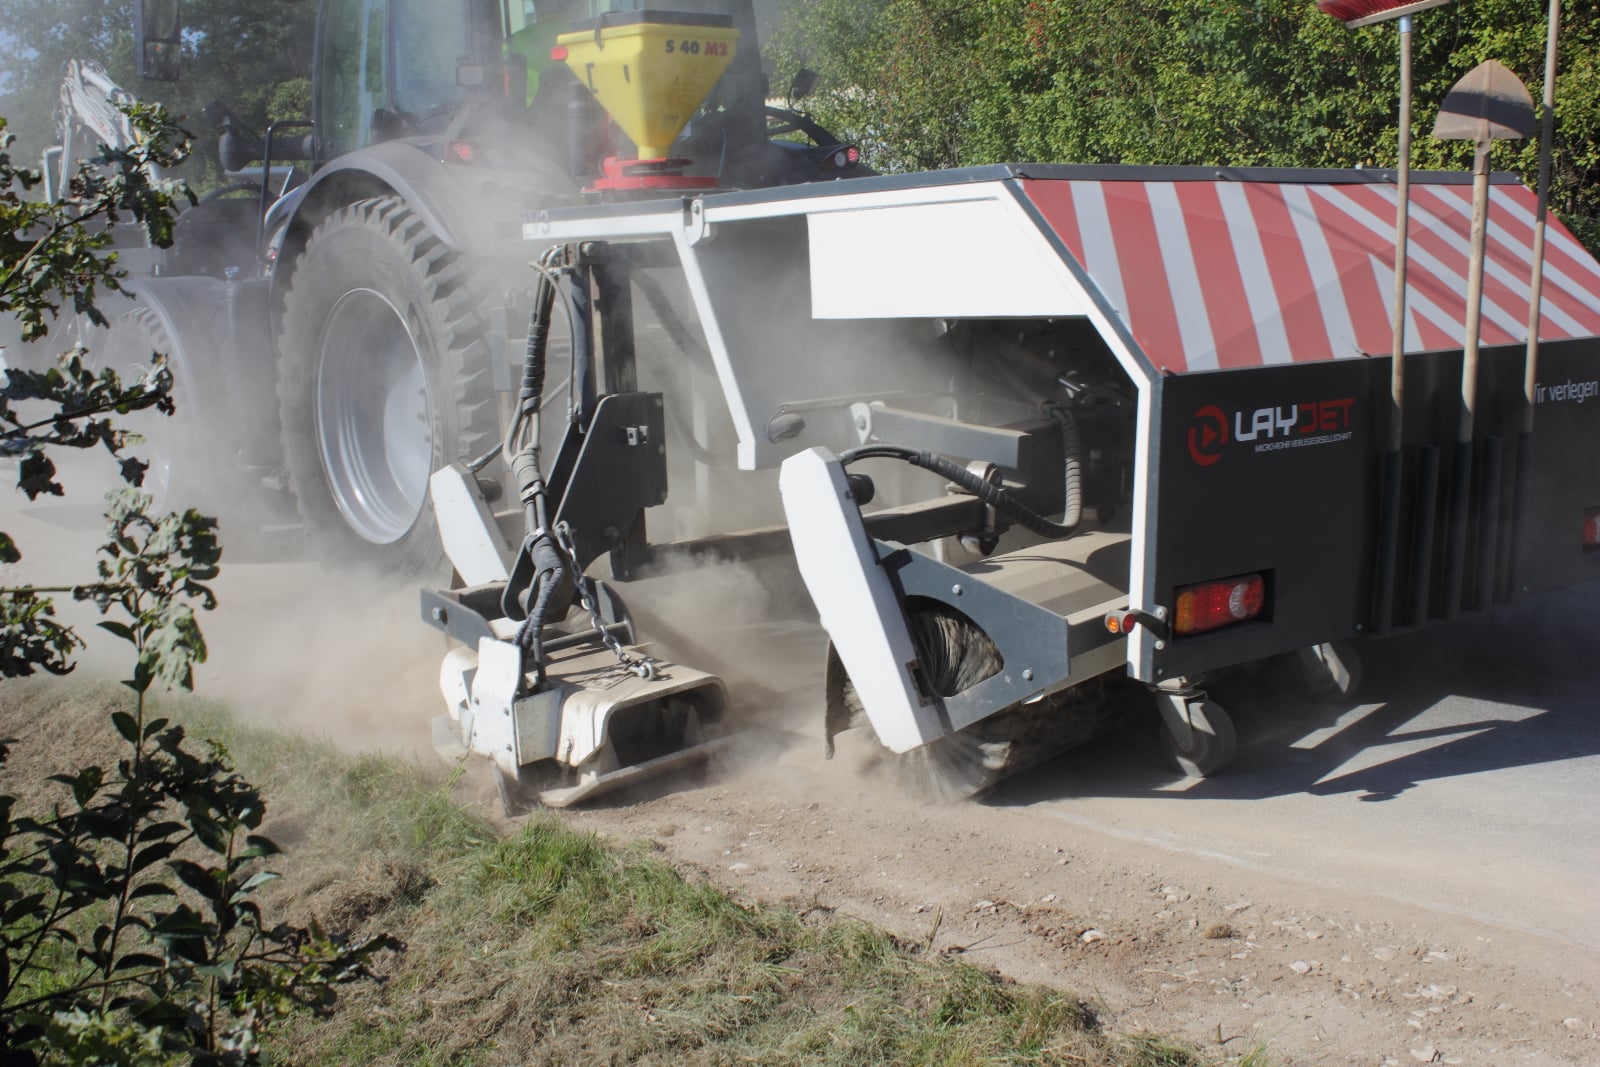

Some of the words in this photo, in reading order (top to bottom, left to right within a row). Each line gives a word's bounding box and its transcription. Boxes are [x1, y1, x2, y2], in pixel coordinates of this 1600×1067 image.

[665, 40, 675, 54] S
[680, 40, 700, 54] 40
[704, 41, 729, 56] M2
[1549, 379, 1598, 404] verlegen
[1234, 398, 1355, 442] LAYJET
